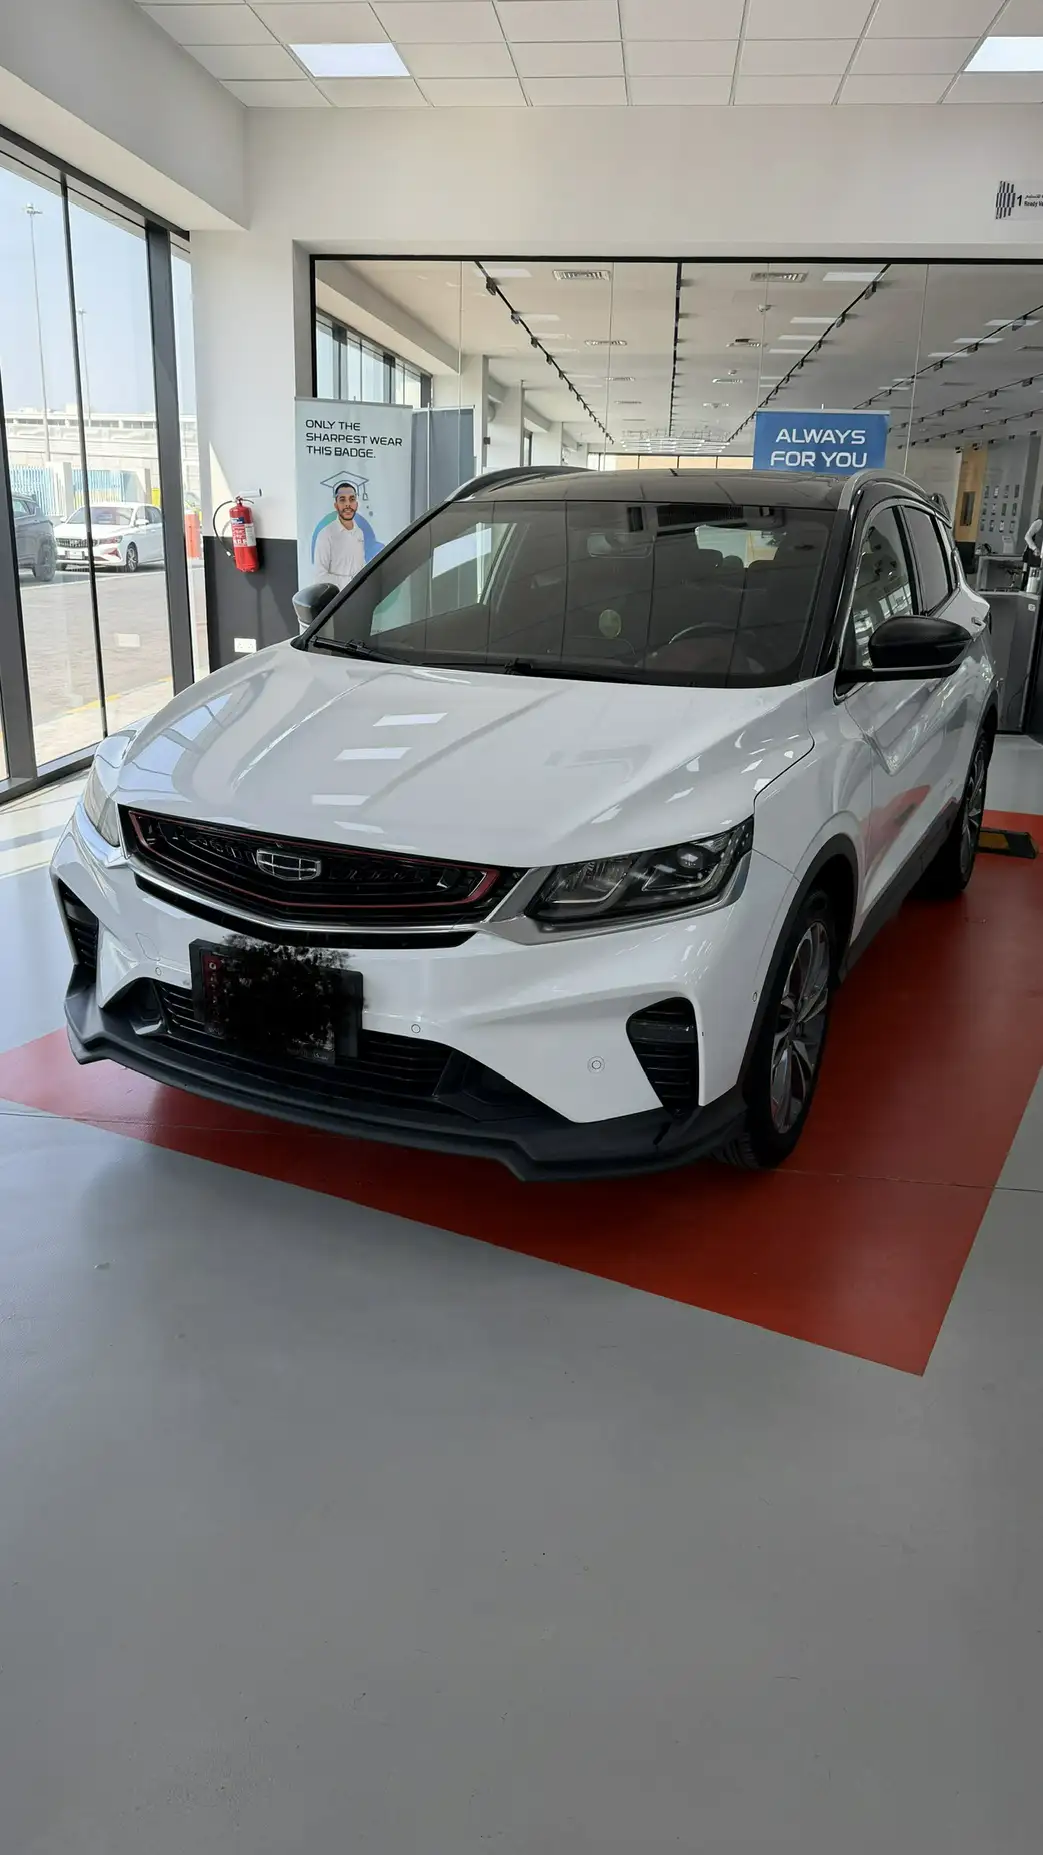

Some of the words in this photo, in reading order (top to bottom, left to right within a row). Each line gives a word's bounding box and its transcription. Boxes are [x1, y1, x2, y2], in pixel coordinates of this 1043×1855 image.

[1016, 194, 1023, 207] 1
[305, 419, 336, 429] ONLY
[338, 421, 361, 431] THE
[305, 432, 368, 445] SHARPEST
[369, 436, 403, 447] WEAR
[775, 428, 866, 445] ALWAYS
[306, 445, 332, 456] THIS
[334, 447, 376, 459] BADGE.
[770, 451, 816, 467] FOR
[821, 452, 868, 468] YOU
